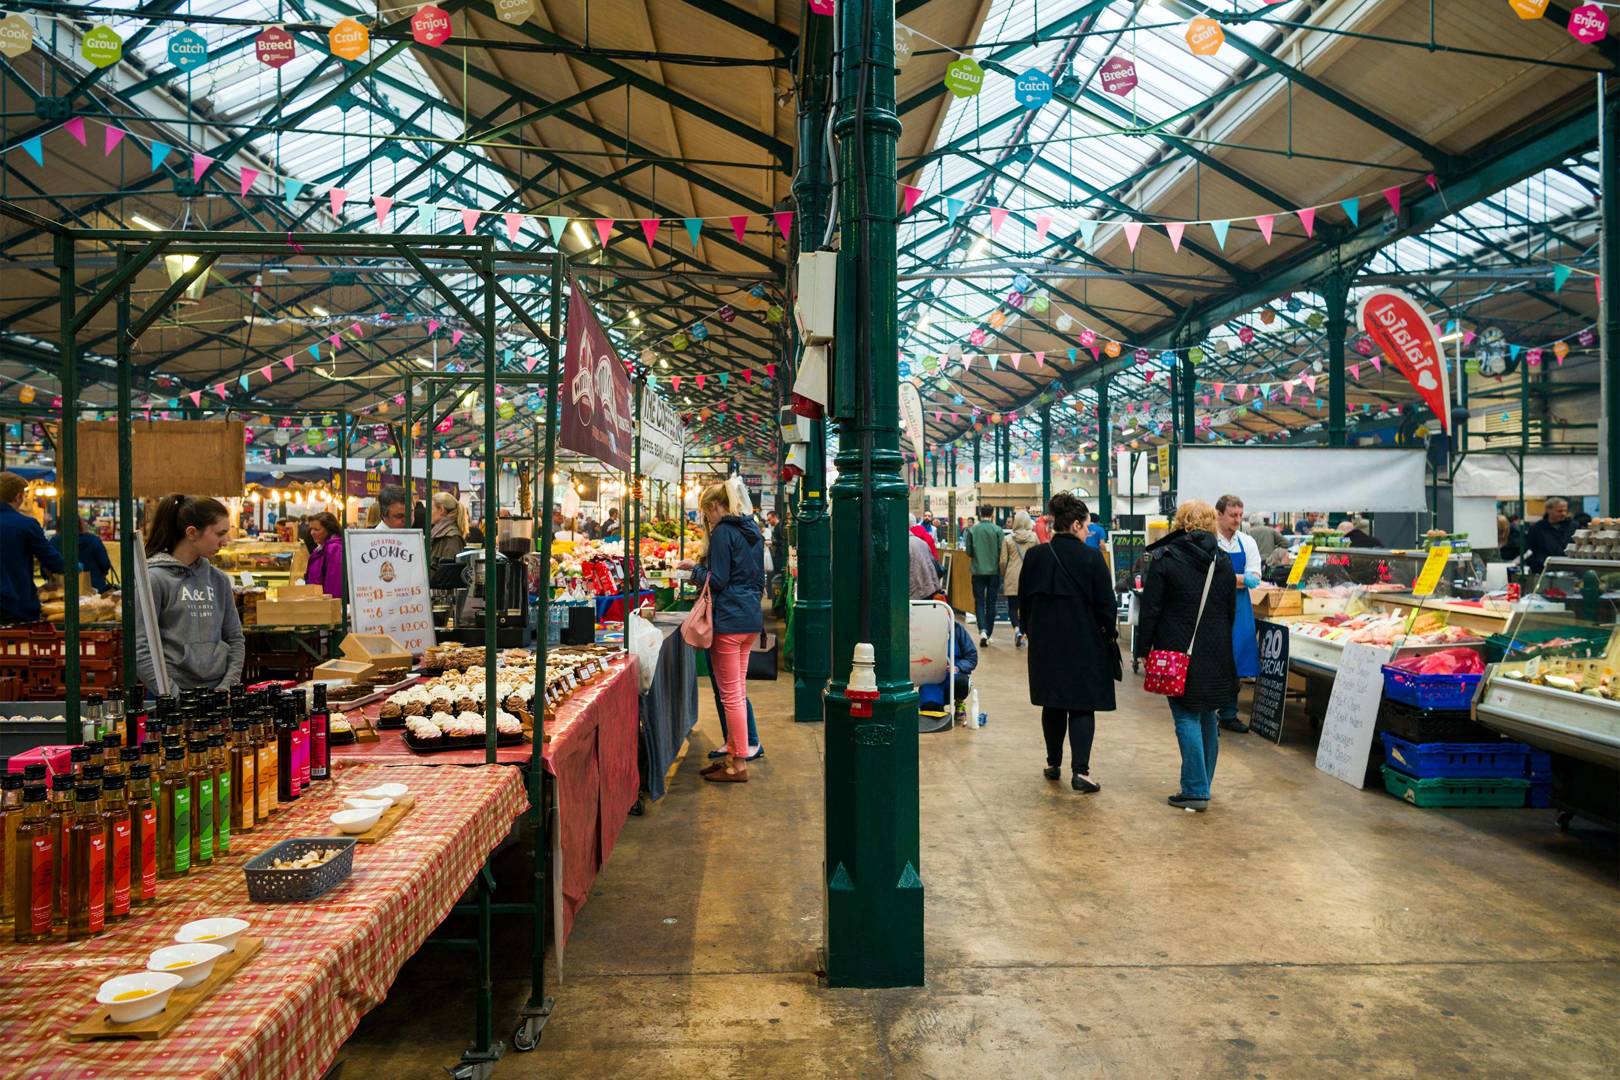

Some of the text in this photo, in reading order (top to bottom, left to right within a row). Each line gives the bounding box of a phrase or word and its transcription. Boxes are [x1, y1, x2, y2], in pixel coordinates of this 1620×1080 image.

[415, 18, 448, 31] Enjoy
[1574, 13, 1605, 32] Enjoy
[0, 26, 29, 40] Cook
[335, 31, 363, 43] Craft
[1192, 25, 1217, 44] Craft
[87, 38, 118, 50] Grow
[171, 43, 205, 53] Catch
[258, 39, 292, 51] Breed
[951, 68, 980, 84] Grow
[1102, 66, 1134, 82] Breed
[1017, 81, 1049, 91] Catch
[361, 545, 415, 564] COOKIES
